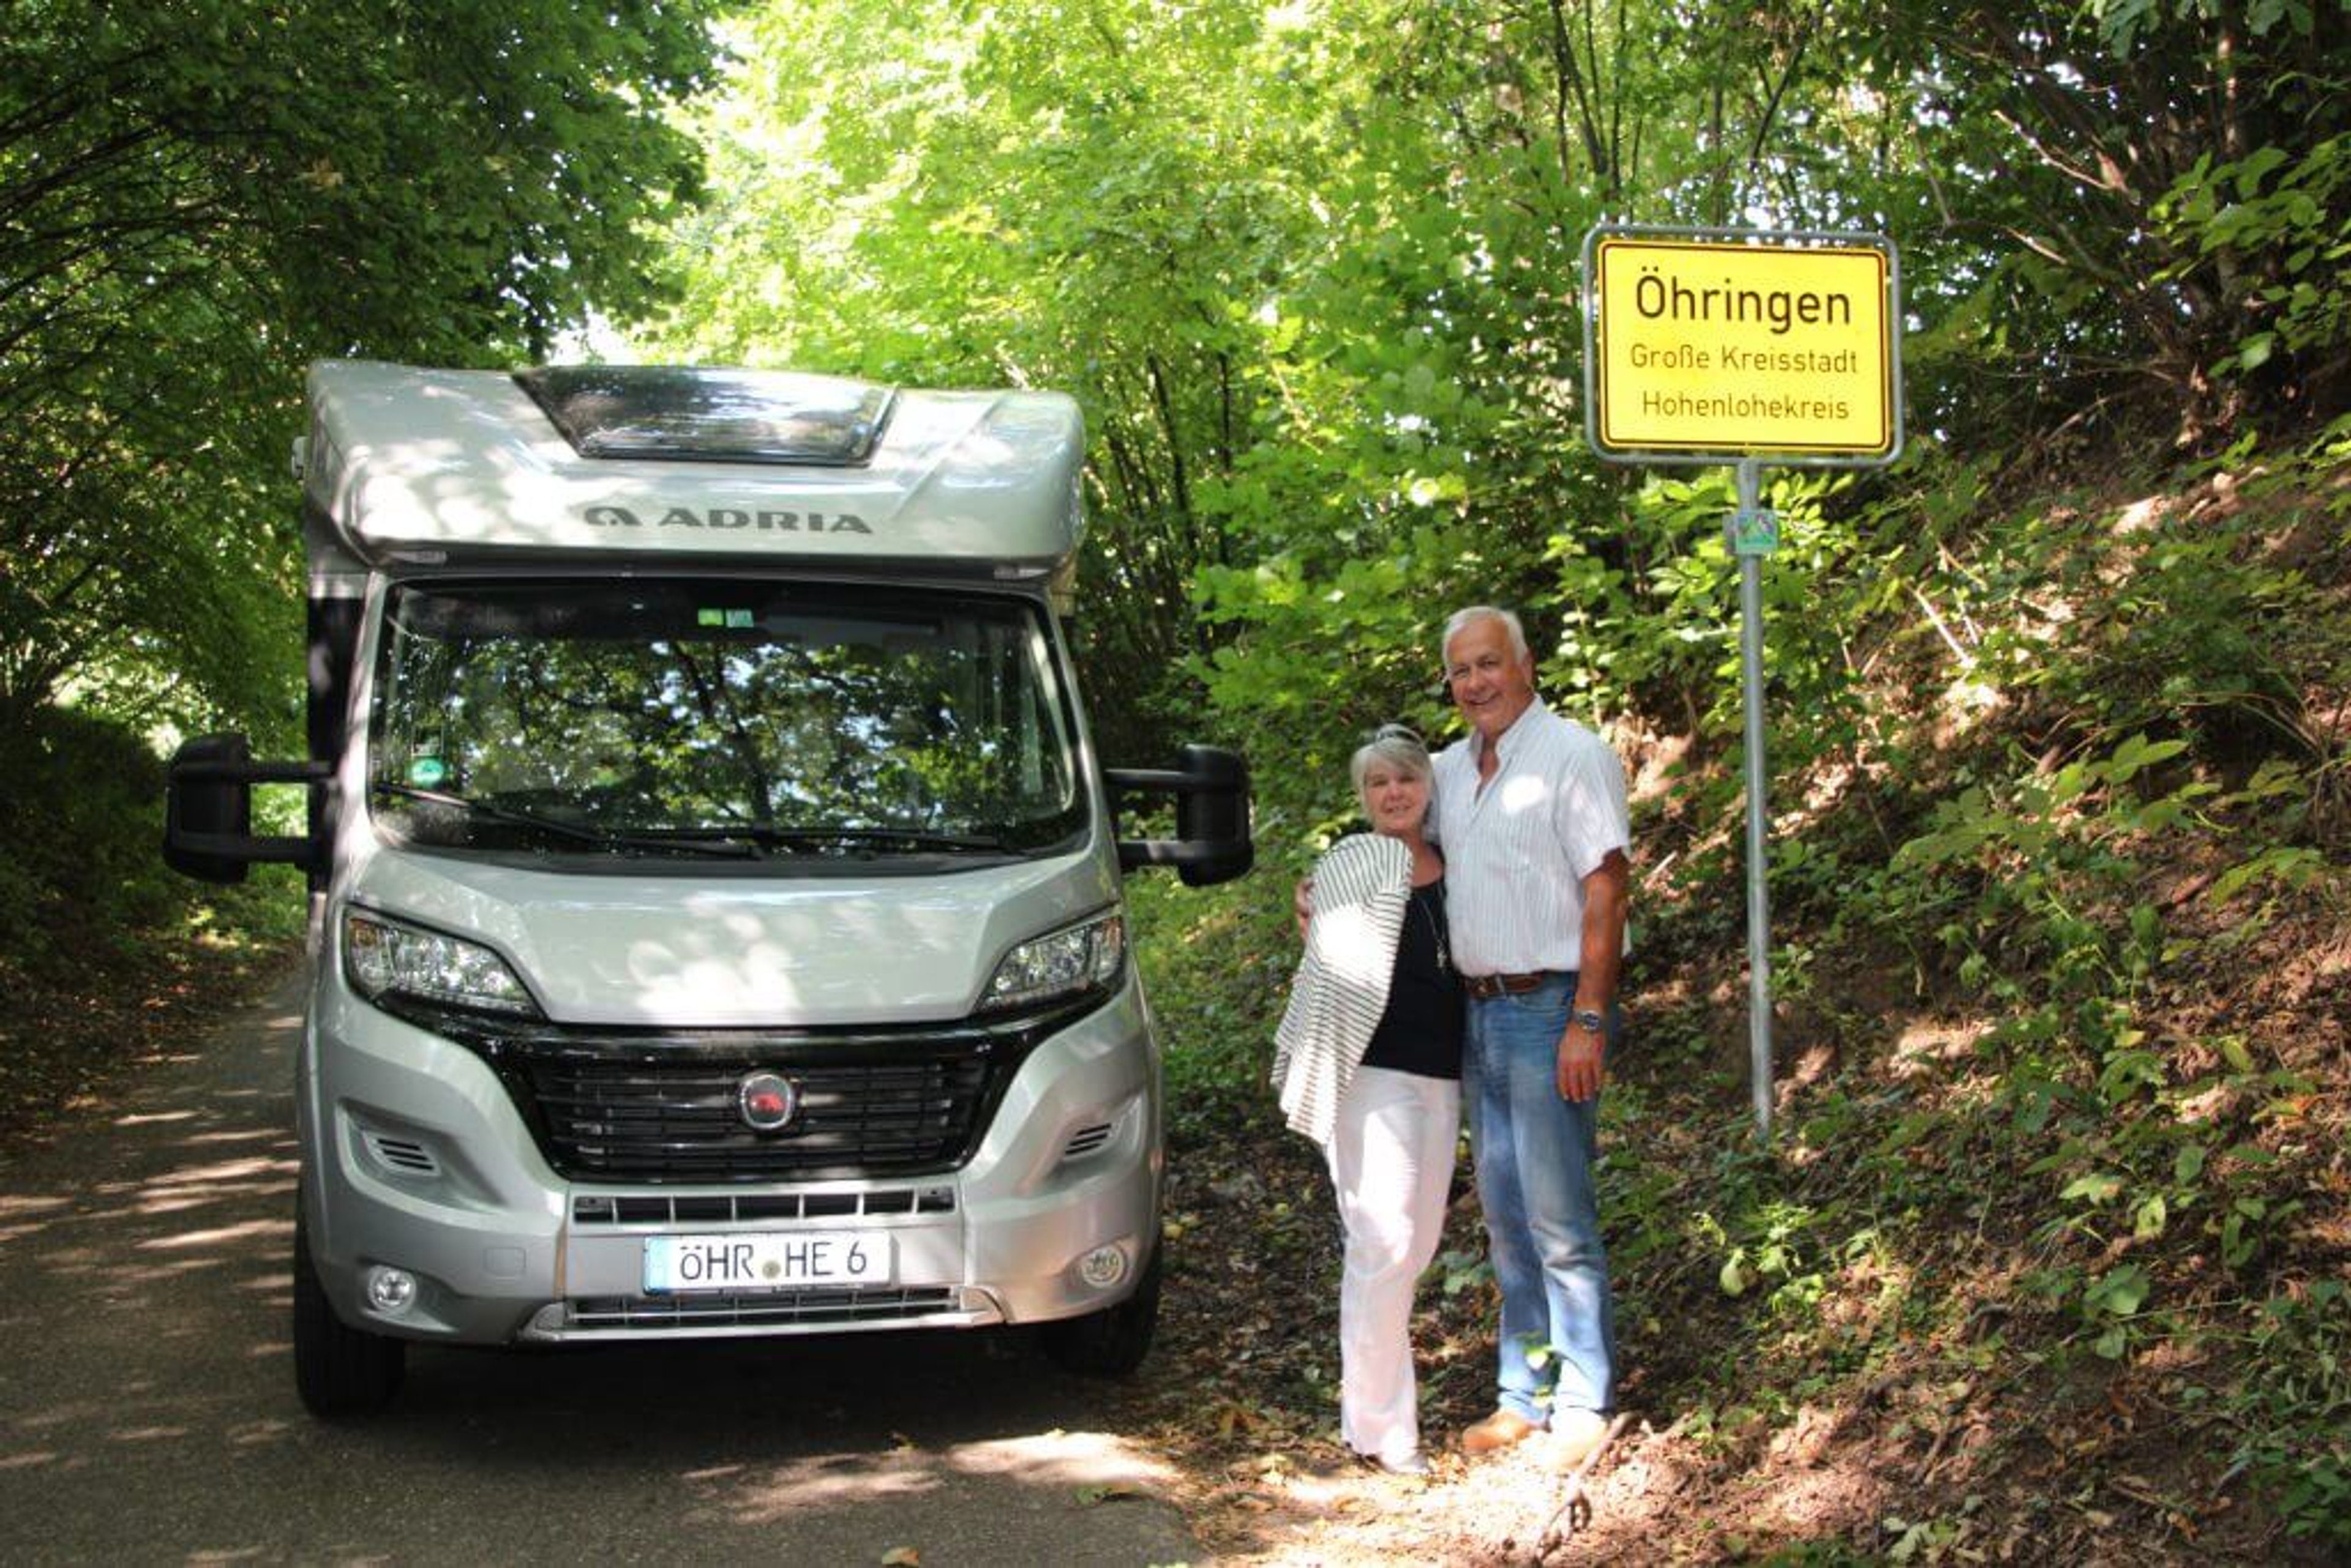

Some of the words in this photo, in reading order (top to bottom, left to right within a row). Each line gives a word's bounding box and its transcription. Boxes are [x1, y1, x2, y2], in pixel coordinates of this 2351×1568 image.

[1636, 266, 1850, 334] Öhringen
[1630, 343, 1710, 370] Große
[1722, 346, 1858, 373] Kreisstadt
[1642, 390, 1850, 419] Hohenlohekreis
[658, 507, 873, 534] ADRIA
[680, 1245, 754, 1280] ÖHR
[785, 1241, 834, 1277] HE
[847, 1240, 868, 1275] 6
